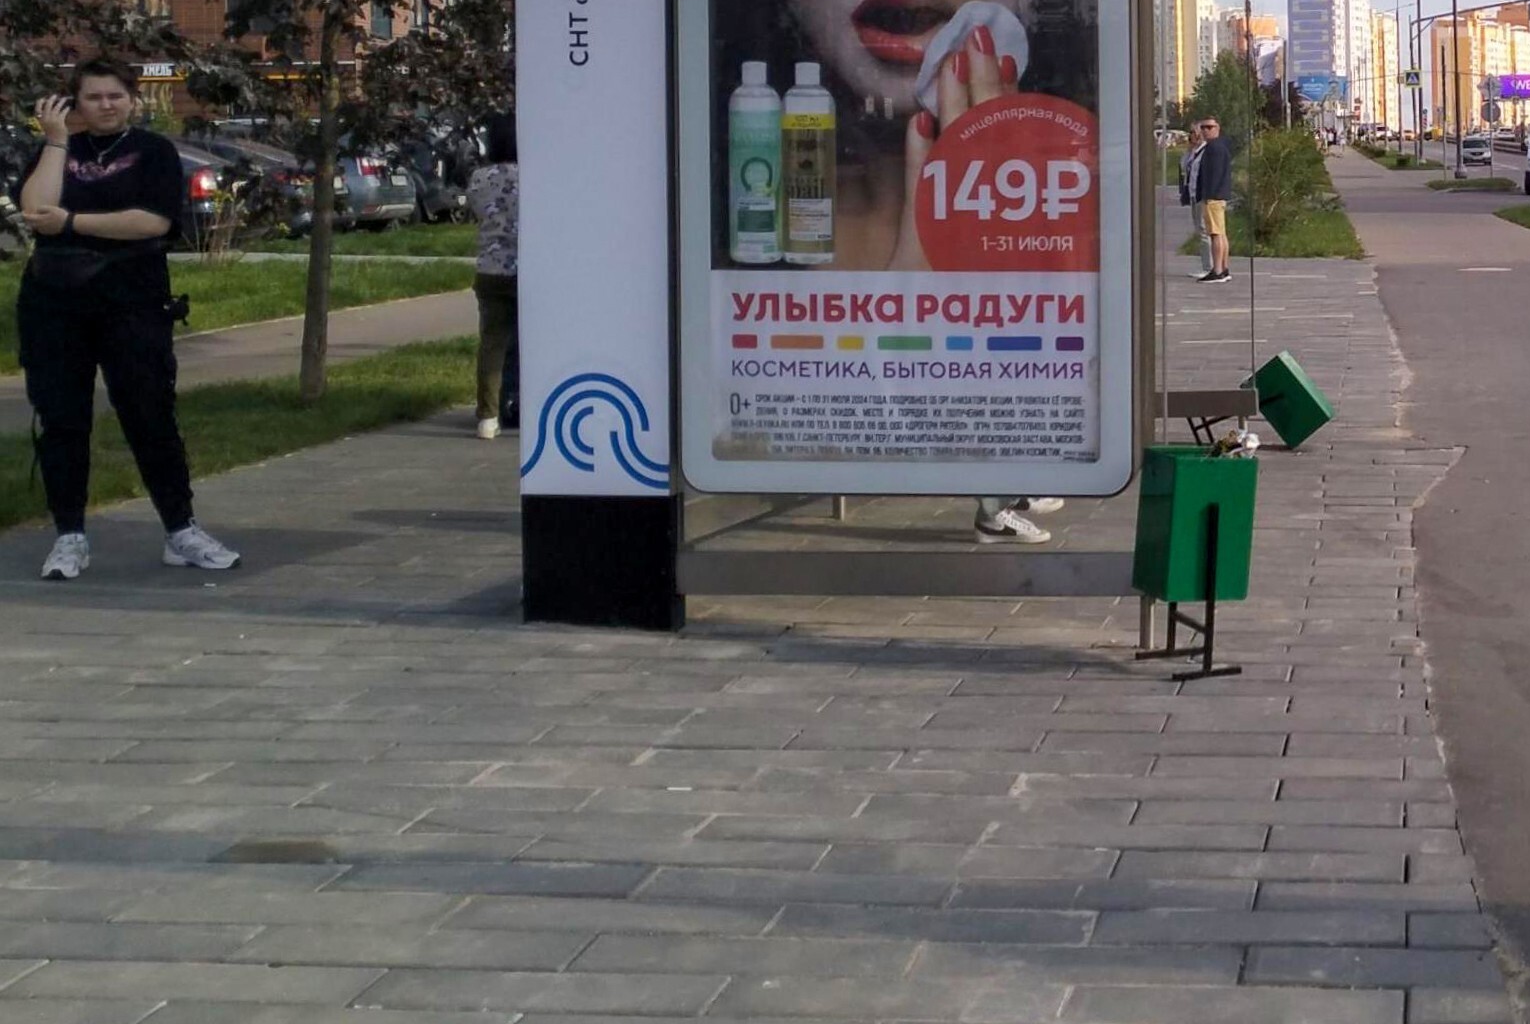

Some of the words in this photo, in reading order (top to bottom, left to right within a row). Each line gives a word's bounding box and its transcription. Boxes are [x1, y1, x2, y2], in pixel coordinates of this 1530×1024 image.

[569, 12, 590, 67] СНТ
[960, 107, 1054, 140] мицеллярная
[1054, 113, 1089, 137] вода
[1018, 235, 1074, 252] ИЮЛЯ
[732, 360, 876, 381] КОСМЕТИКА,
[883, 361, 992, 378] БЫТОВАЯ
[999, 361, 1084, 379] ХИМИЯ
[730, 392, 752, 416] 0+
